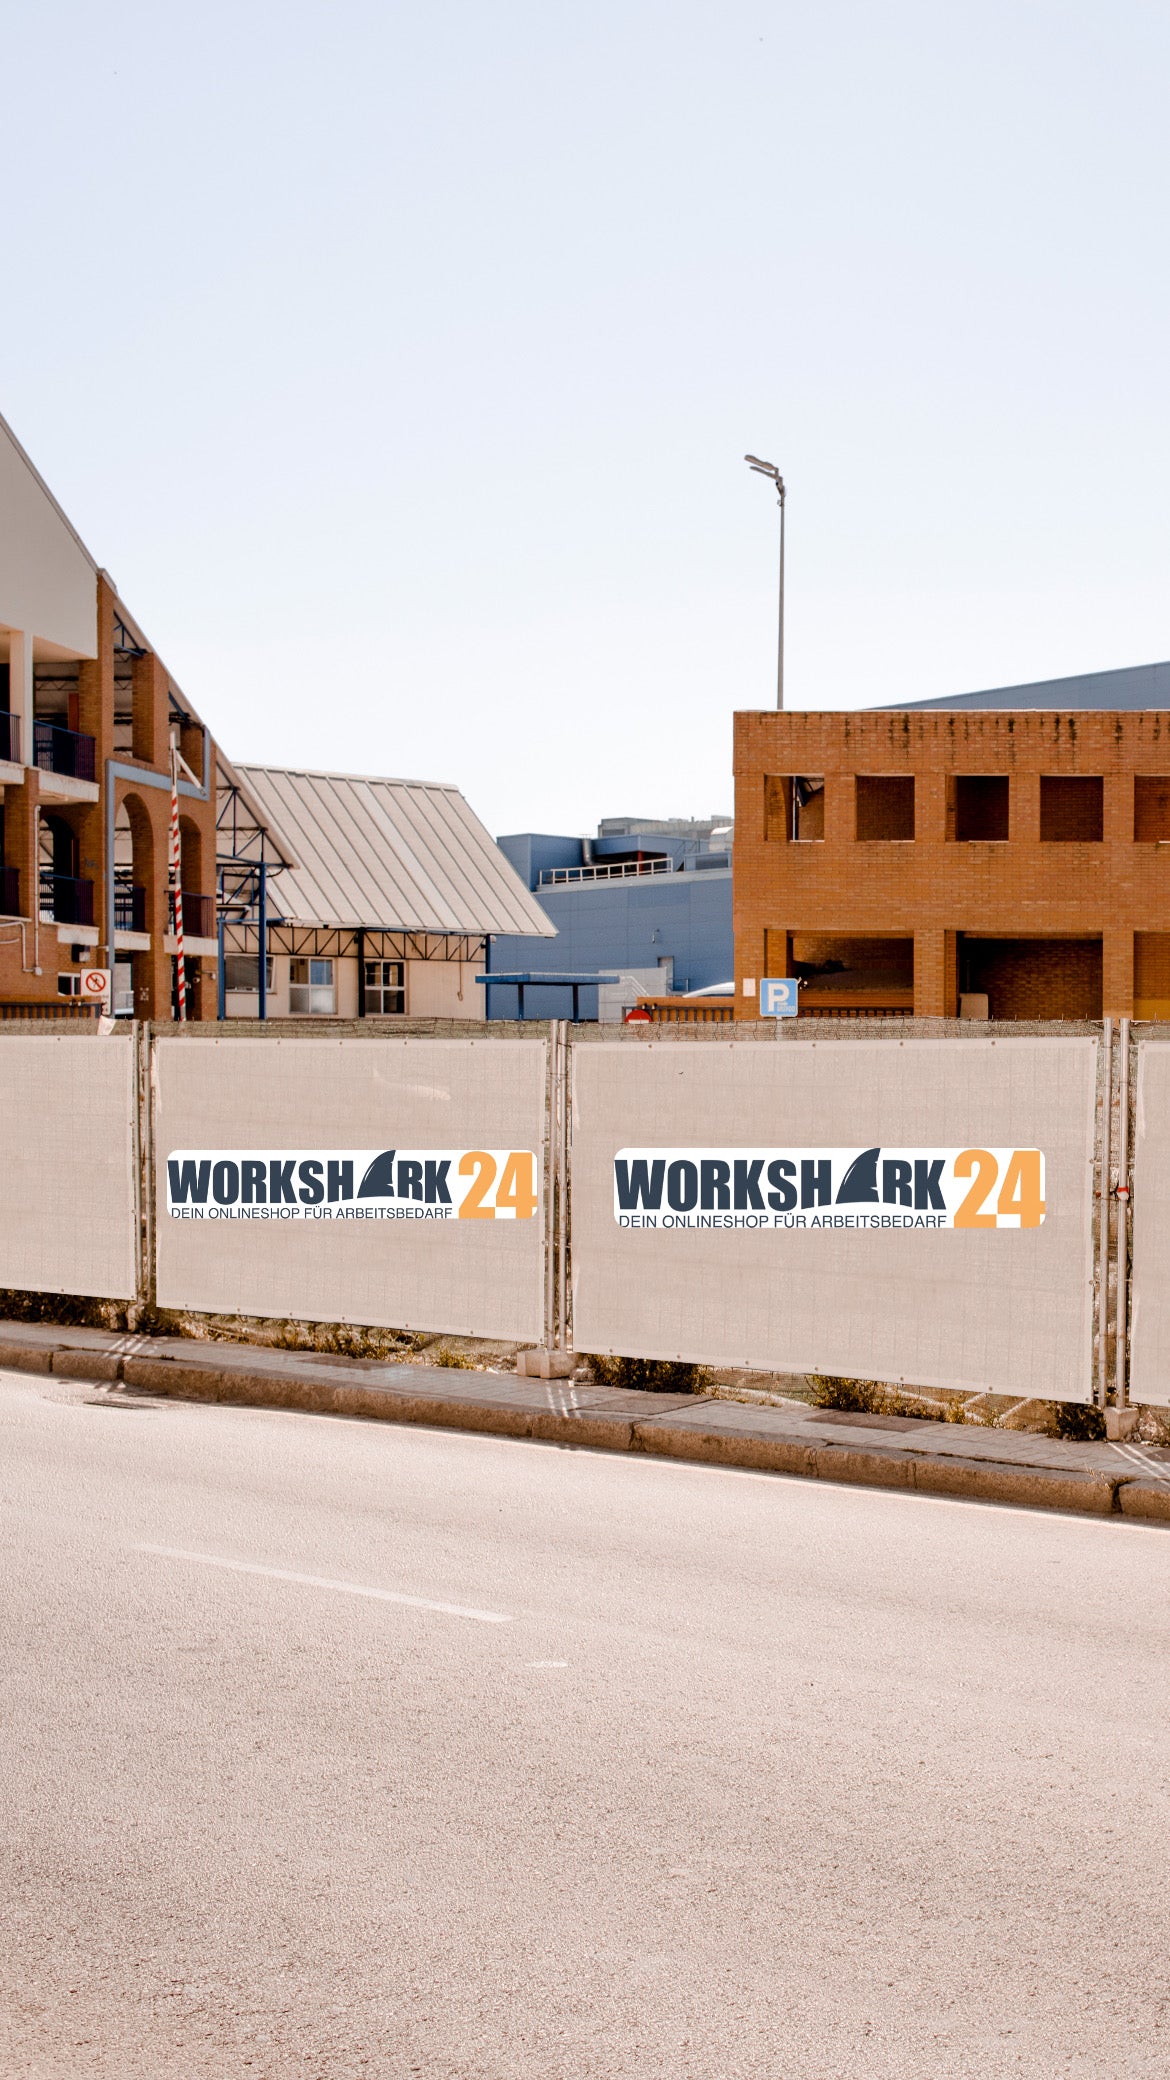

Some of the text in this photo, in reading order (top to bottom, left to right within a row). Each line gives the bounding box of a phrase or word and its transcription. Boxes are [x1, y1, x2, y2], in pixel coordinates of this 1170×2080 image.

[767, 982, 790, 1012] P
[171, 1205, 453, 1219] DEIN ONLINESHOP FÜR ARBEITSBEDARF
[619, 1212, 947, 1228] DEIN ONLINESHOP FÜR ARBEITSBEDARF
